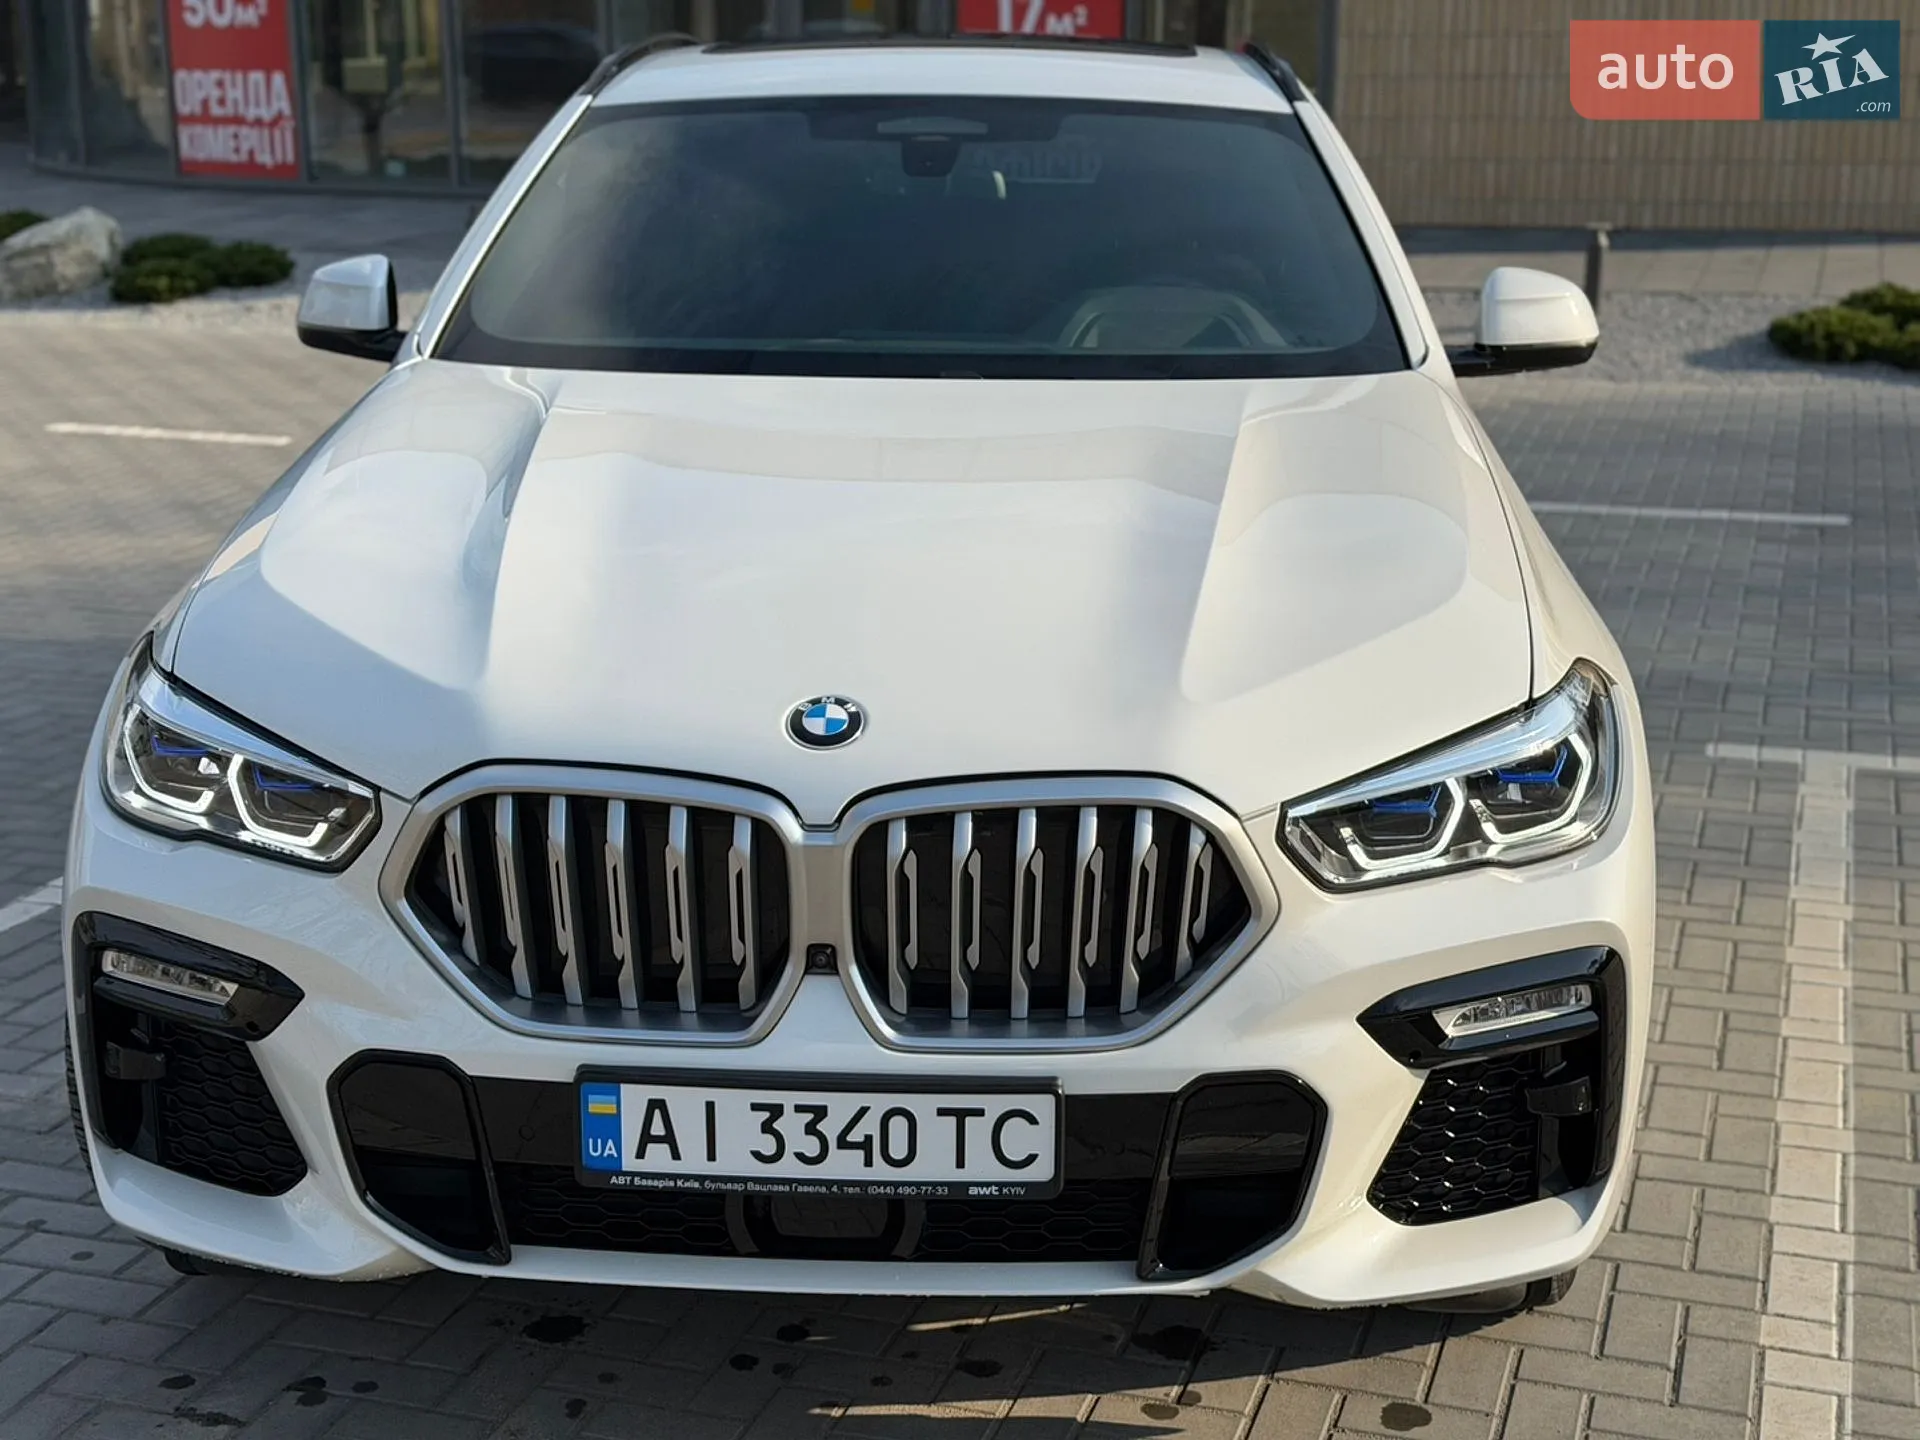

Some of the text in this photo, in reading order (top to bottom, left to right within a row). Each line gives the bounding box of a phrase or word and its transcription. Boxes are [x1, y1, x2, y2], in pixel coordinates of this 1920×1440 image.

[174, 69, 292, 123] ОРЕНДА
[178, 119, 296, 169] КОМЕРЦІЇ
[588, 1138, 618, 1158] UA
[749, 1102, 917, 1168] 3340
[609, 1175, 632, 1185] АВТ
[704, 1180, 745, 1192] бульвар
[747, 1181, 790, 1193] Вацлава
[867, 1185, 895, 1196] (044)
[896, 1186, 949, 1196] 490-77-33
[968, 1185, 1026, 1195] awt KYIV
